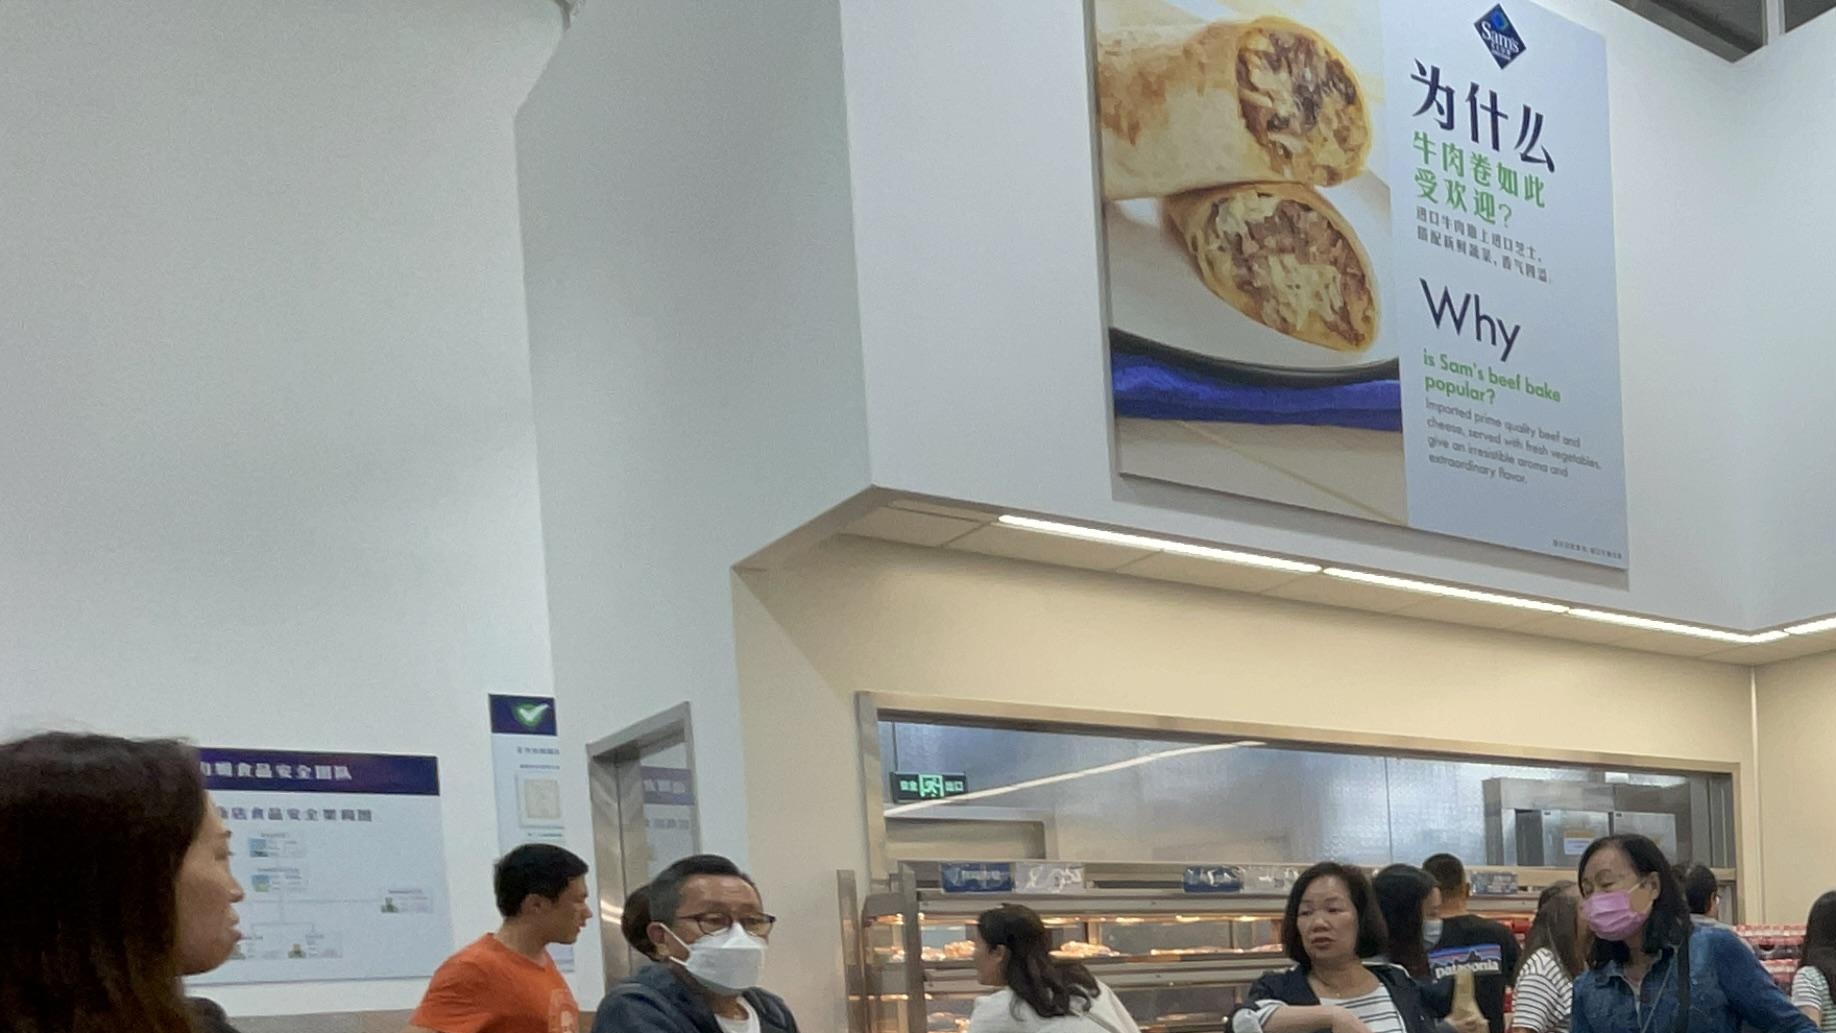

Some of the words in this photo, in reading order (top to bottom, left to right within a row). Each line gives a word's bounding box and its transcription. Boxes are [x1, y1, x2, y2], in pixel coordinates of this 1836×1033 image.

[1410, 58, 1555, 173] 为什么
[1413, 131, 1546, 208] 牛肉卷如此
[1414, 167, 1513, 228] 受欢迎？
[1419, 278, 1520, 362] Why
[1423, 348, 1436, 367] is
[1440, 353, 1485, 381] Sam's
[1488, 366, 1521, 392] beef
[1525, 376, 1562, 402] bake
[1425, 374, 1496, 404] popular?
[1425, 399, 1472, 420] Imported
[1474, 412, 1502, 428] prime
[1504, 422, 1536, 438] quality
[1538, 427, 1561, 442] beef
[1562, 436, 1581, 448] and
[1426, 416, 1466, 437] cheese,
[1469, 429, 1501, 445] served
[1504, 437, 1523, 449] with
[1525, 440, 1549, 456] fresh
[1427, 435, 1450, 449] give
[1452, 442, 1466, 452] an
[1517, 458, 1549, 473] aroma
[1550, 465, 1569, 478] and
[1428, 453, 1497, 479] extraordinary
